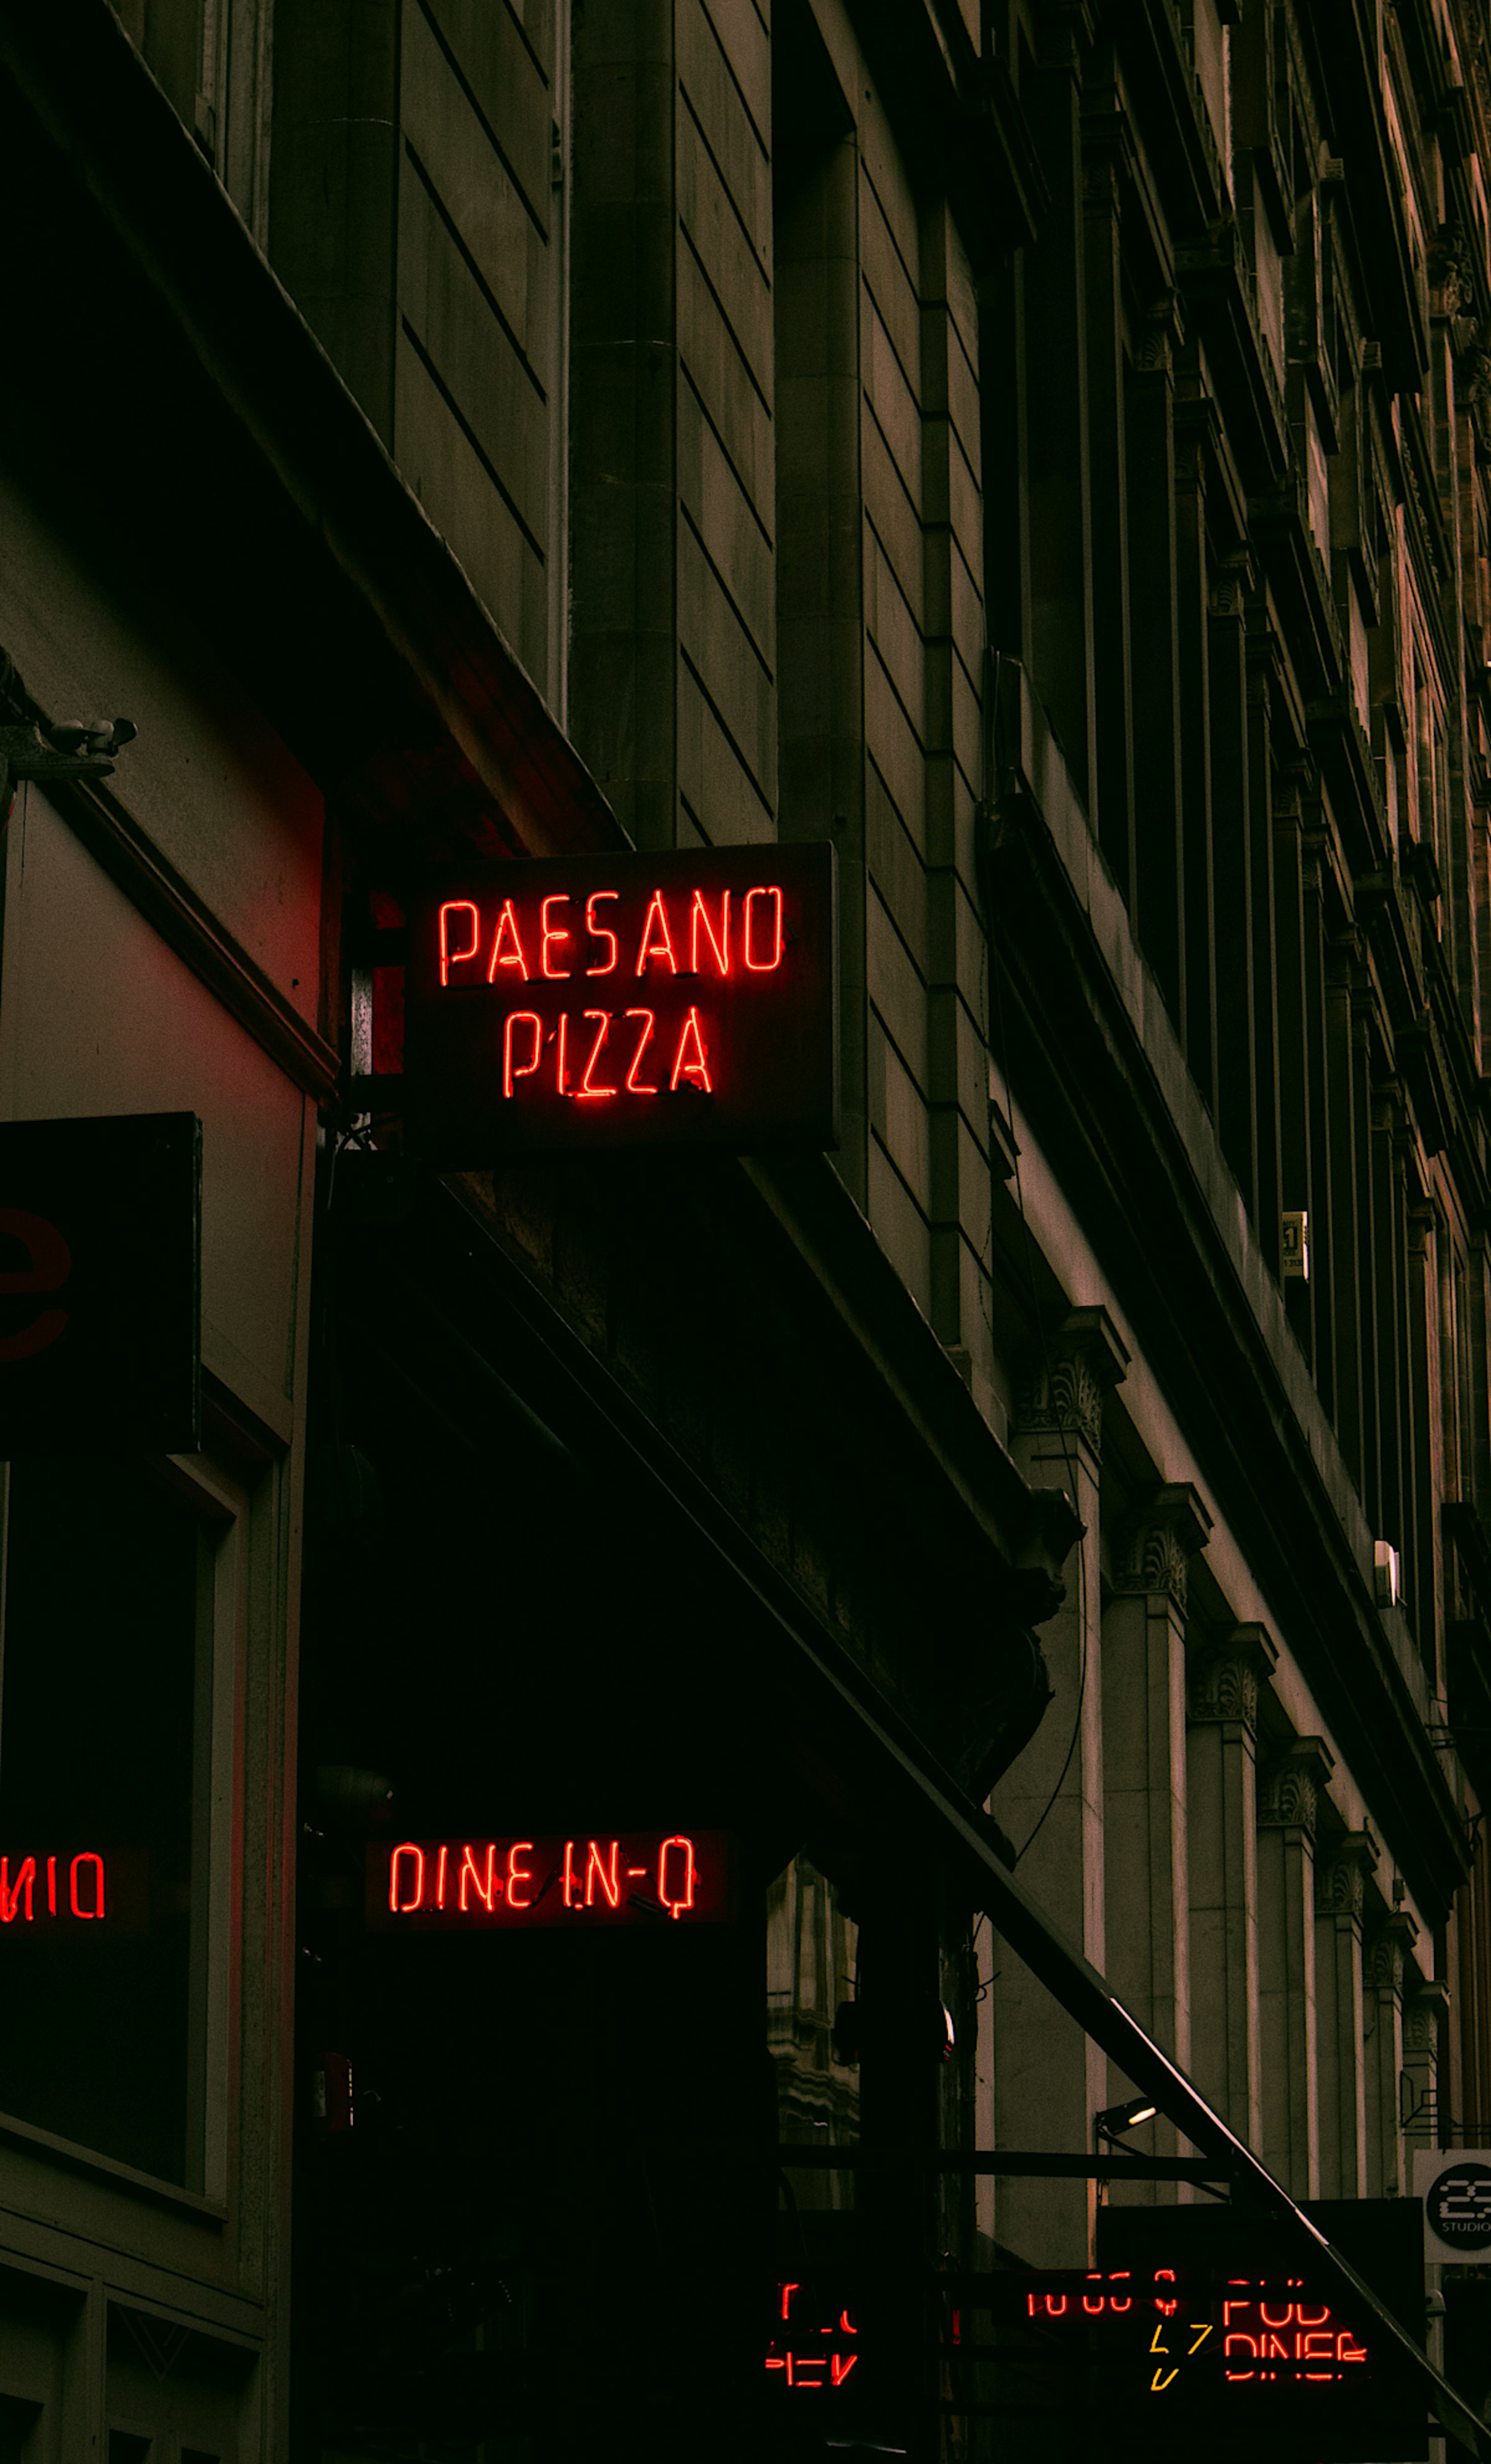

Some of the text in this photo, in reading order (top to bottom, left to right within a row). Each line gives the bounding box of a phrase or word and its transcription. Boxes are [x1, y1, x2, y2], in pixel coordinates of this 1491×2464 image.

[439, 886, 785, 987] PAESANO
[503, 1005, 712, 1098] PIZZA
[389, 1842, 533, 1912] DINE
